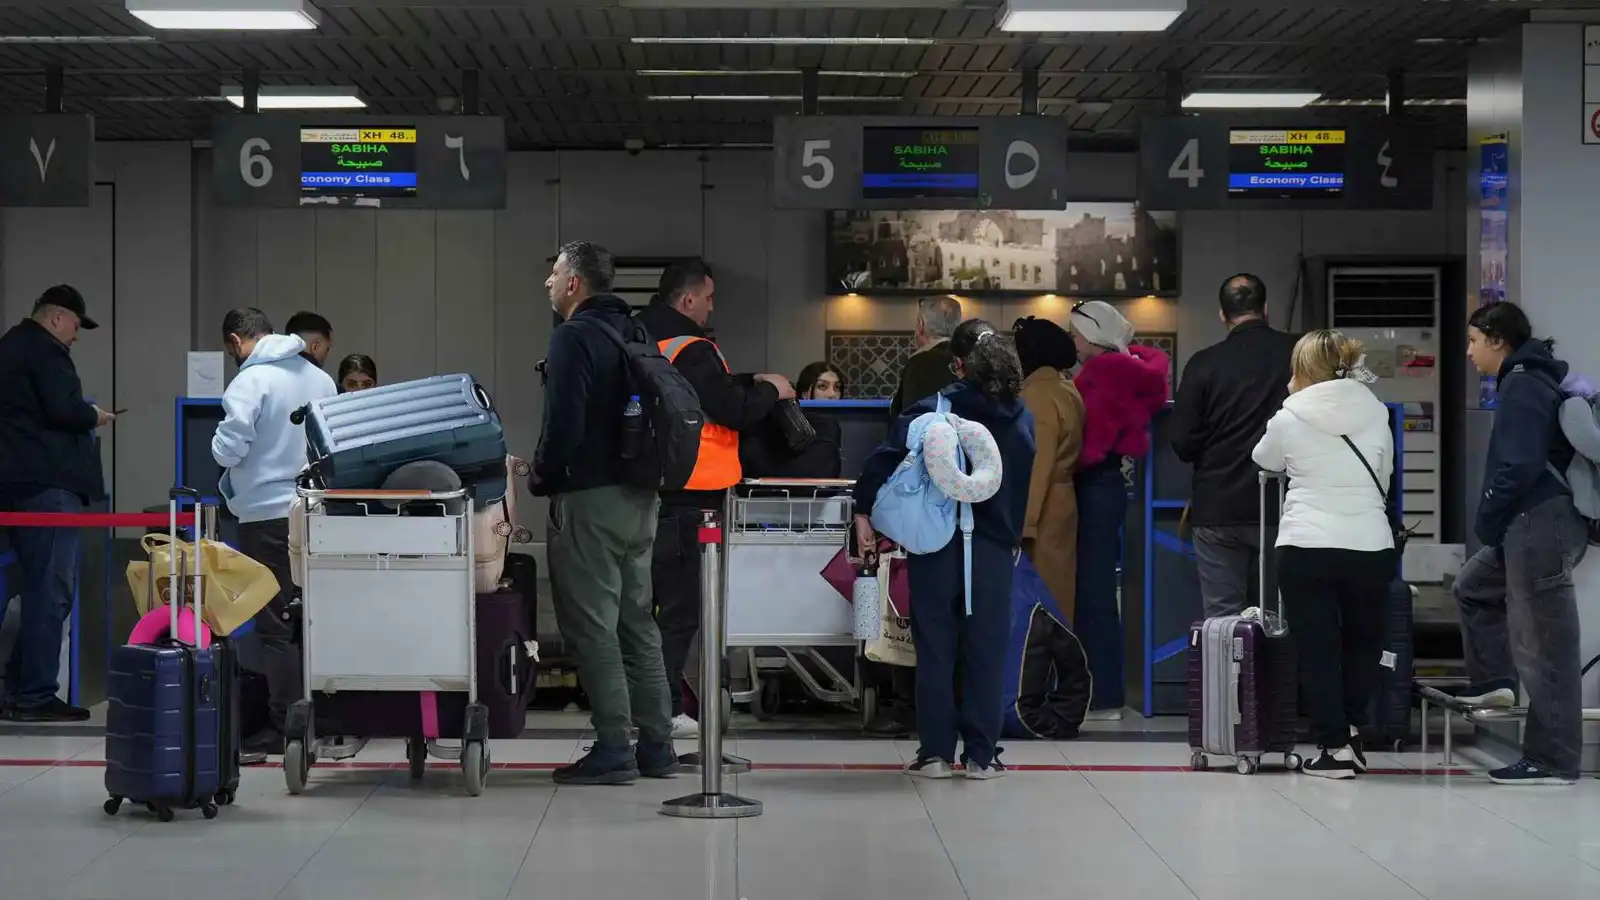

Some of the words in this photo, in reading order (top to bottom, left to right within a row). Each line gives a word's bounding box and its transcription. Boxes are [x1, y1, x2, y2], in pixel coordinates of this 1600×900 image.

[363, 131, 382, 139] XH
[1290, 132, 1308, 140] XH
[331, 144, 389, 153] SABIHA
[893, 145, 948, 155] SABIHA
[1259, 145, 1313, 154] SABIHA
[240, 138, 273, 187] 6
[337, 156, 382, 169] صبيحة
[445, 132, 470, 181] ٦
[801, 139, 834, 190] 5
[899, 157, 943, 171] صبيحة
[1005, 140, 1040, 189] ٥
[1168, 138, 1205, 188] 4
[1265, 158, 1308, 170] صبيحة
[355, 174, 391, 184] Class
[1250, 175, 1307, 186] Economy
[1310, 175, 1344, 185] Class
